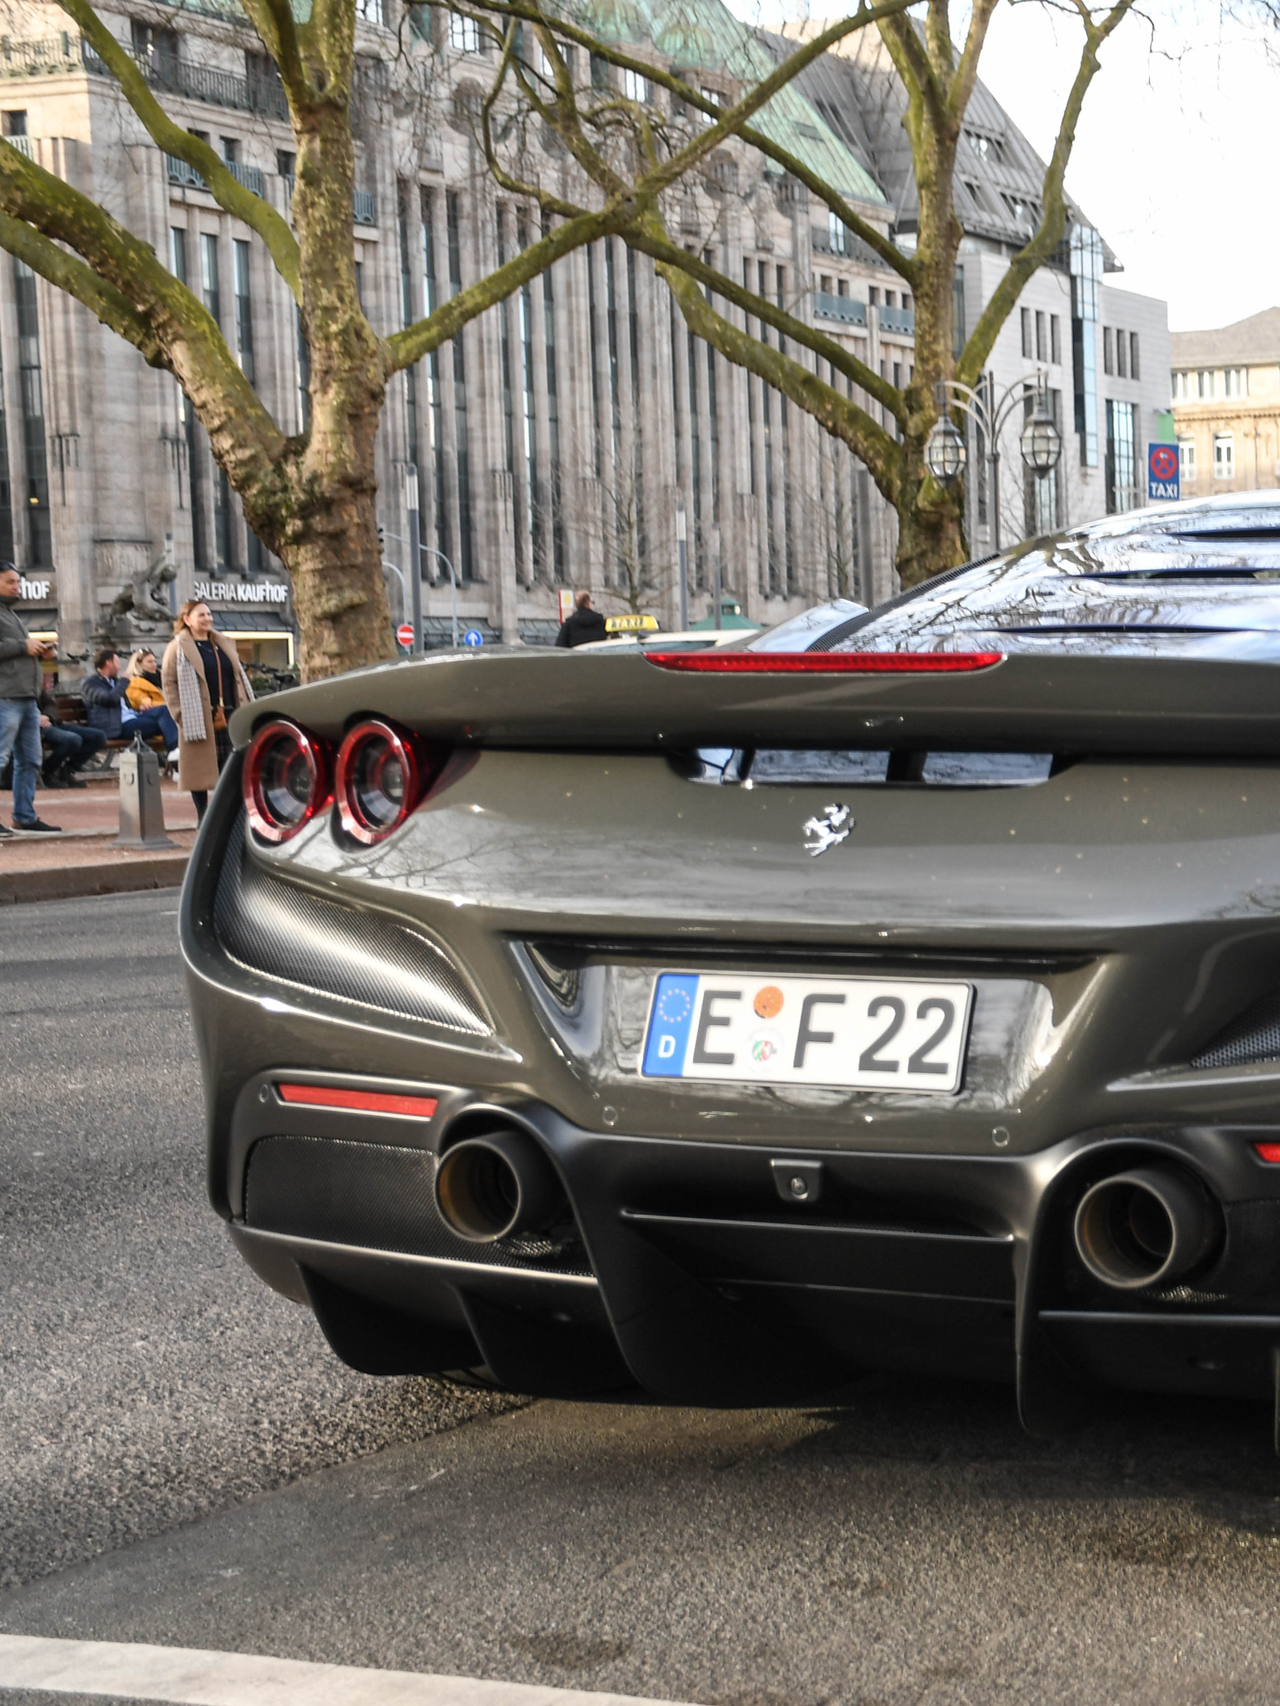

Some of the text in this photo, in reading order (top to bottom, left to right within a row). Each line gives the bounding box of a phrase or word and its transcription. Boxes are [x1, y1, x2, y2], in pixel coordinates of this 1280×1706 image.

[1150, 481, 1178, 499] TAXI
[657, 989, 956, 1075] D E F 22
